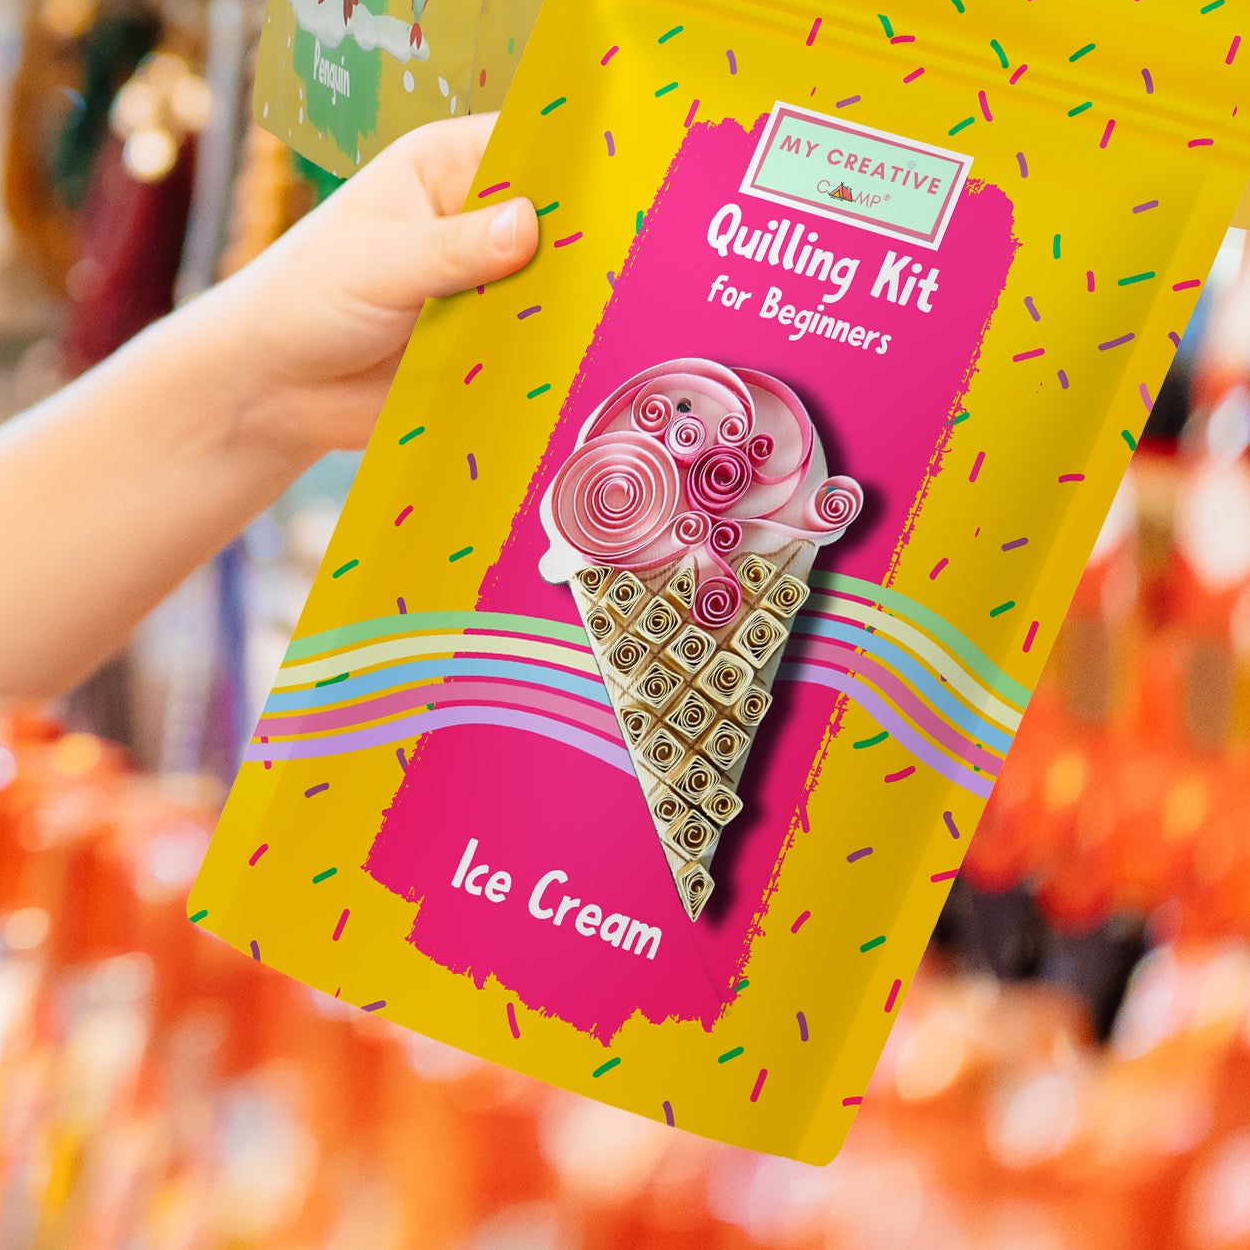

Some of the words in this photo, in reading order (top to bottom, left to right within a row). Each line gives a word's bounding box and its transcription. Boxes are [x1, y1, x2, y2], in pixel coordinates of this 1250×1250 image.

[313, 37, 350, 106] Penguin
[779, 134, 820, 158] MY
[827, 149, 942, 196] CREATIVE
[707, 203, 860, 304] Quilling
[870, 250, 940, 313] Kit
[707, 275, 752, 311] for
[759, 286, 892, 355] Beginners
[451, 837, 512, 903] Ice
[528, 869, 662, 960] Cream
